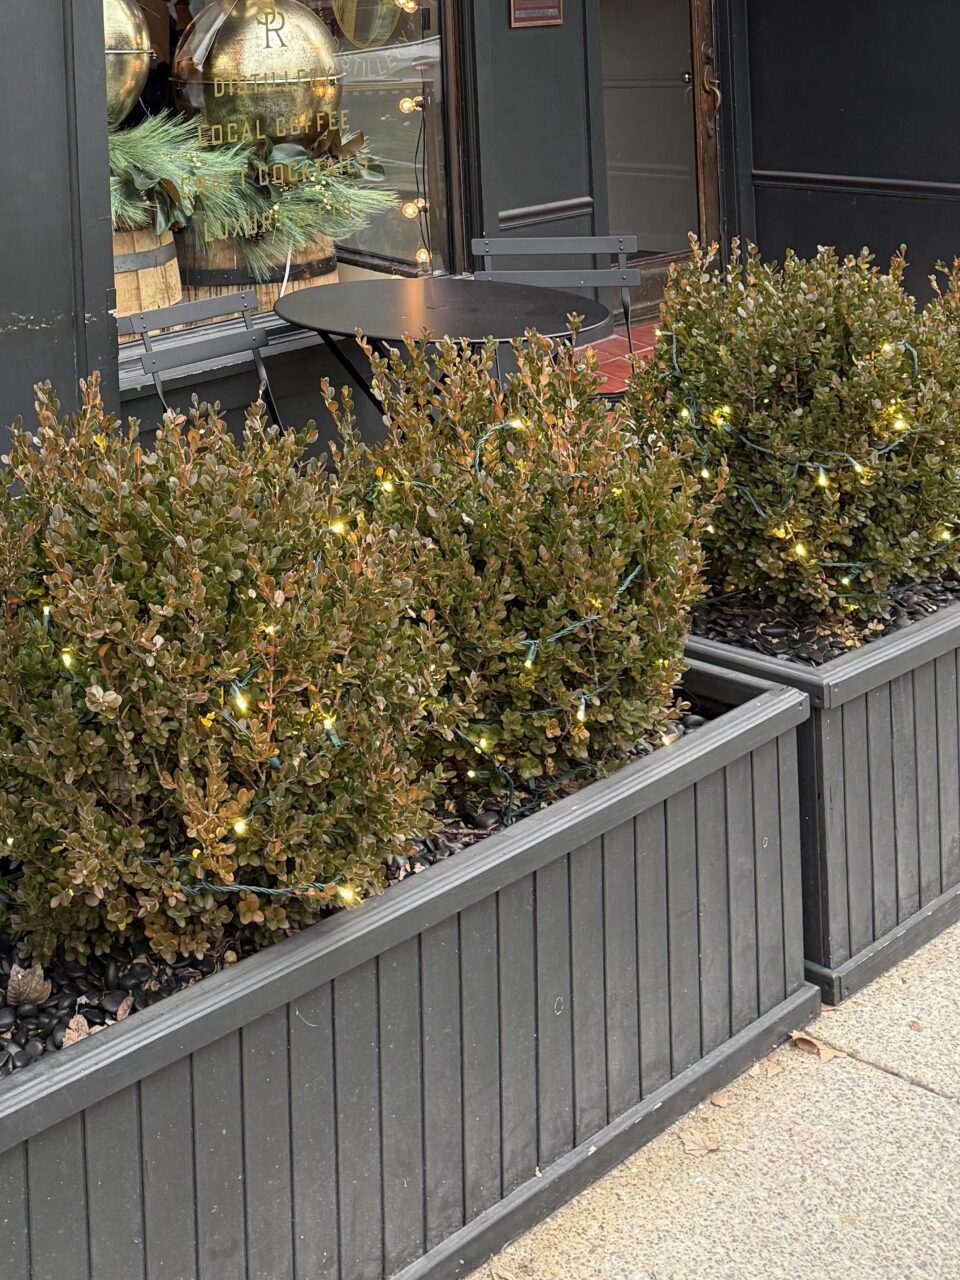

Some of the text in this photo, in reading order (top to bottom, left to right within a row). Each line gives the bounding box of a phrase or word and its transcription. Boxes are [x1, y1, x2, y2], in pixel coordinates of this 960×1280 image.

[214, 66, 332, 98] DISTILLERY
[197, 109, 351, 147] LOCAL COFFEE
[259, 154, 369, 186] COCKTAILS
